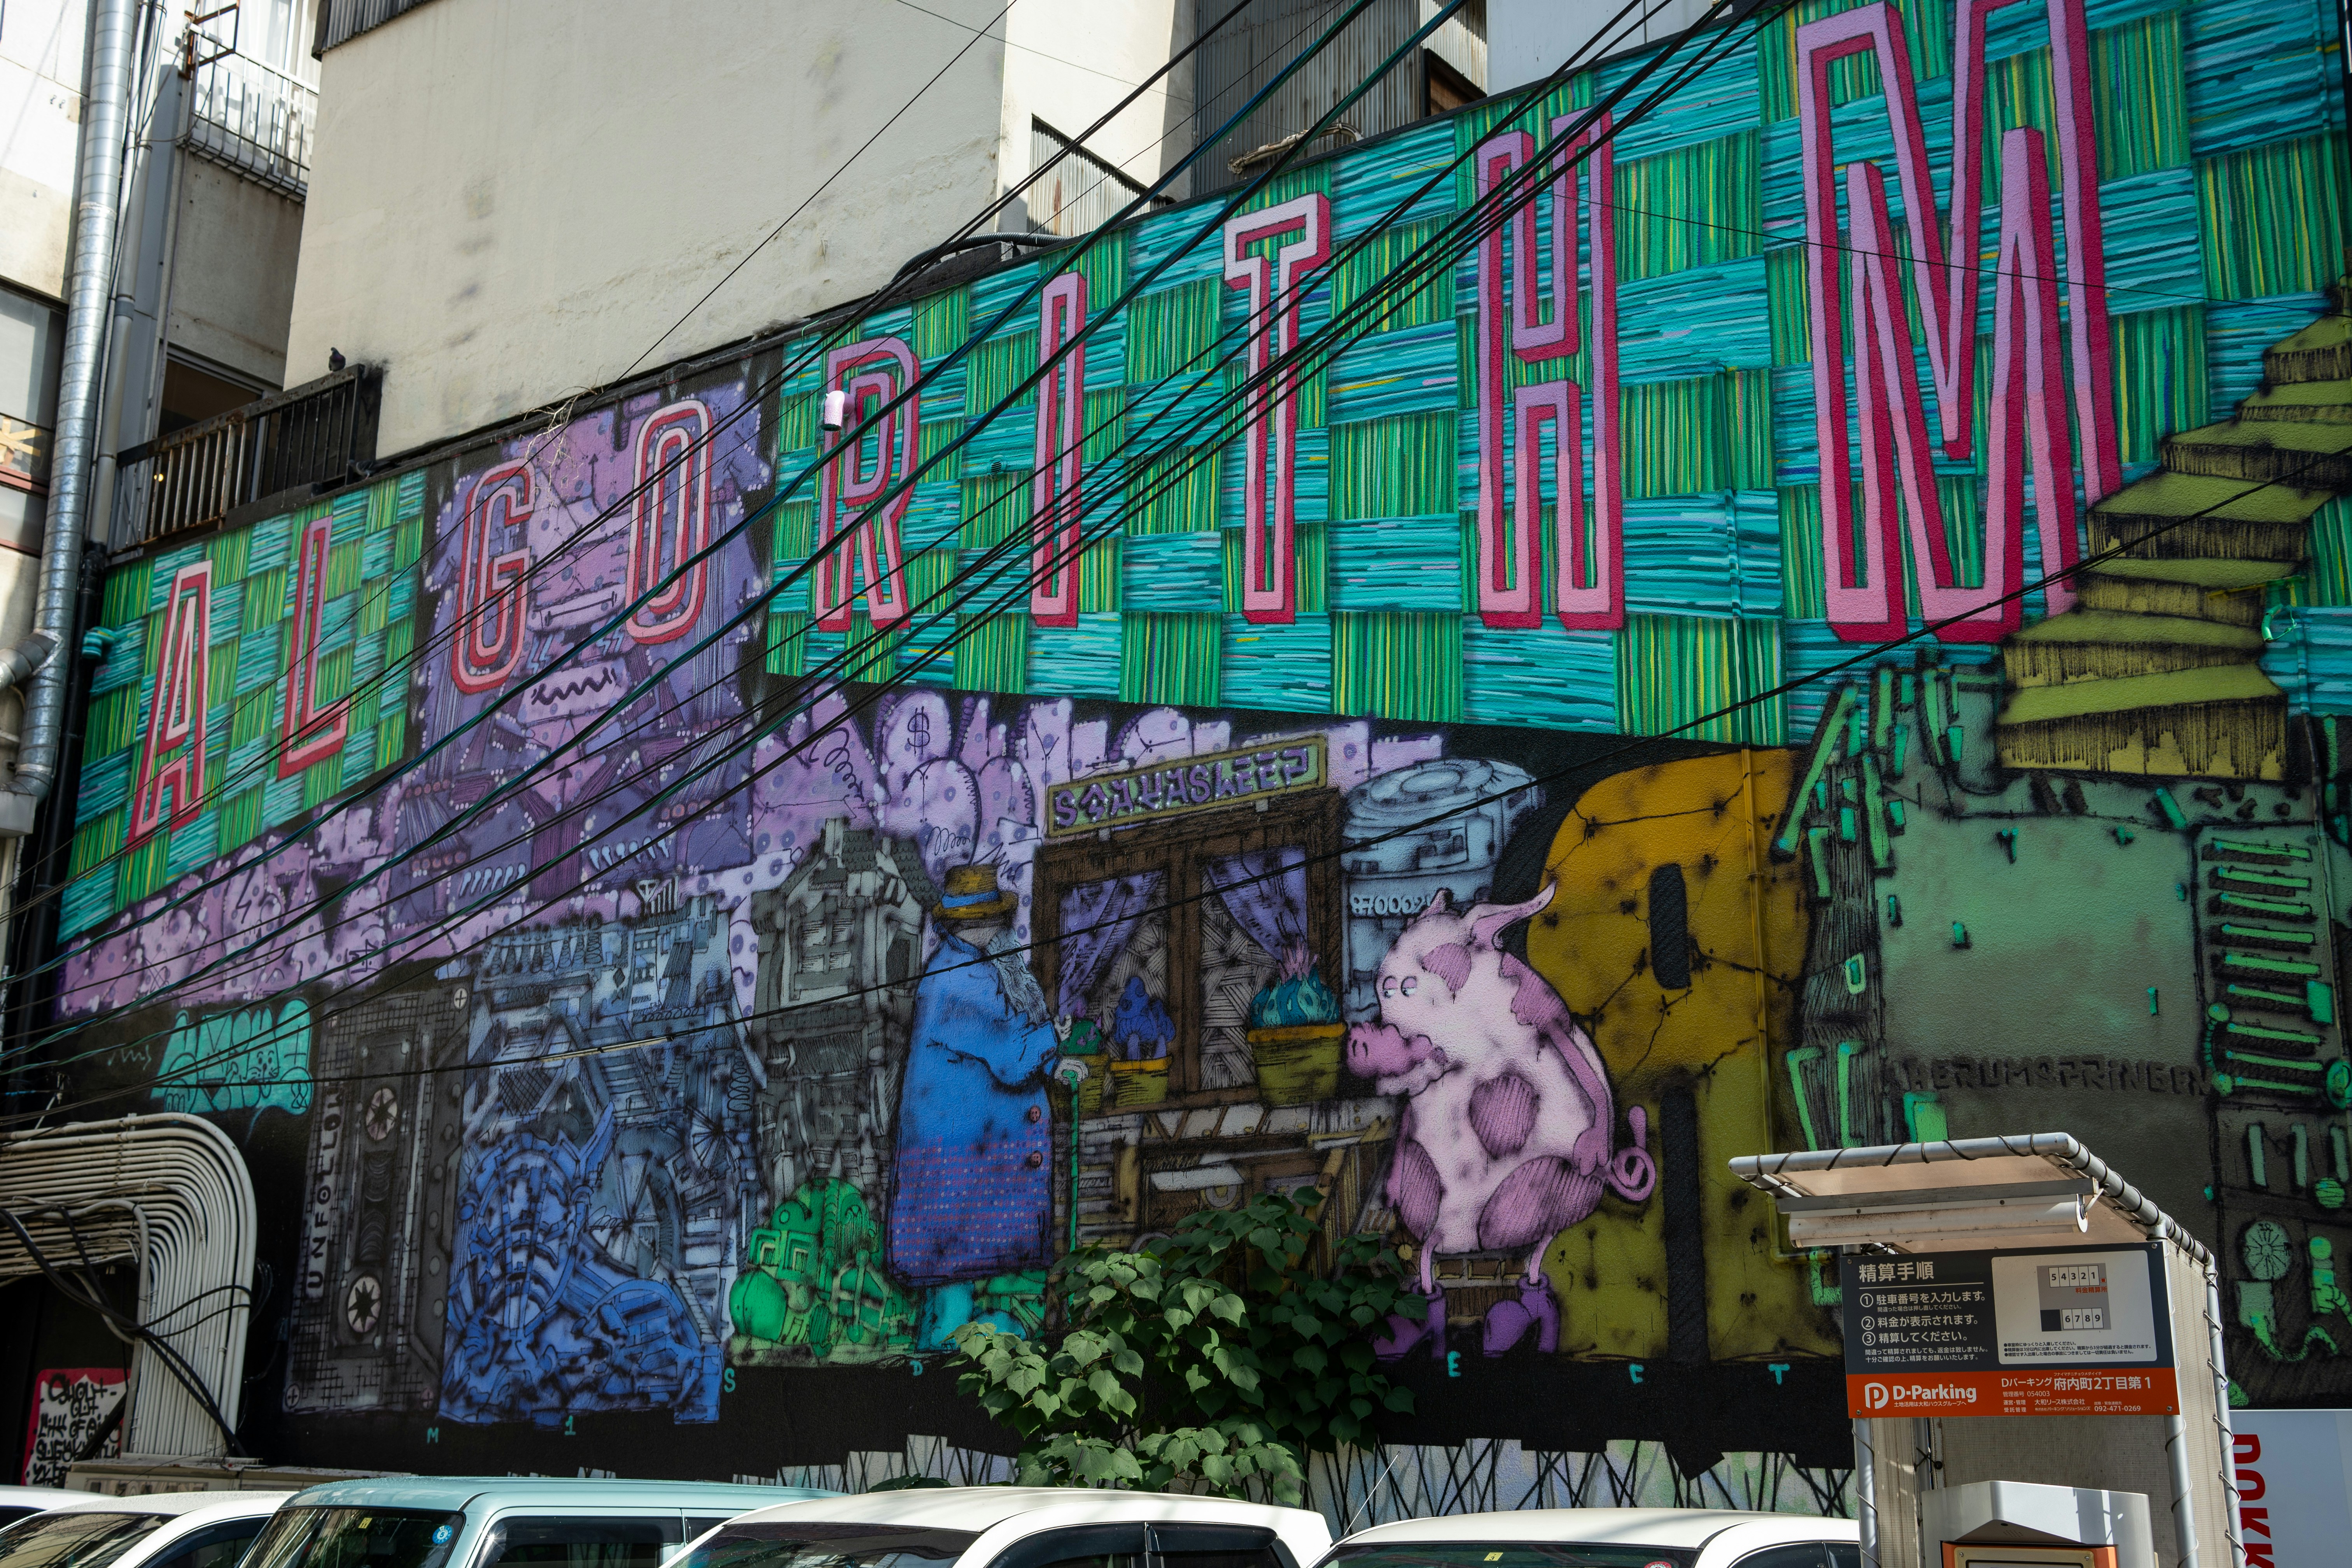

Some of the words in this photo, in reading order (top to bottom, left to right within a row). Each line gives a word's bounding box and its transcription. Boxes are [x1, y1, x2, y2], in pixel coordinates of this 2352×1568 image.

[1859, 1261, 1934, 1283] 精算手順
[1876, 1291, 1985, 1306] 駐車番号を入力します。
[1877, 1304, 1962, 1312] 間違った場合は押し直してください。
[1877, 1314, 1978, 1328] 料金が表示されます。
[1879, 1331, 1967, 1344] 精算してください。
[1865, 1346, 1988, 1356] 間違って精算されましても、返金は致しません。
[1865, 1354, 1978, 1363] 十分ご確認の上、精算をお願いいたします。
[2001, 1377, 2052, 1388] Dパーキング
[1892, 1383, 1977, 1403] D-Parking
